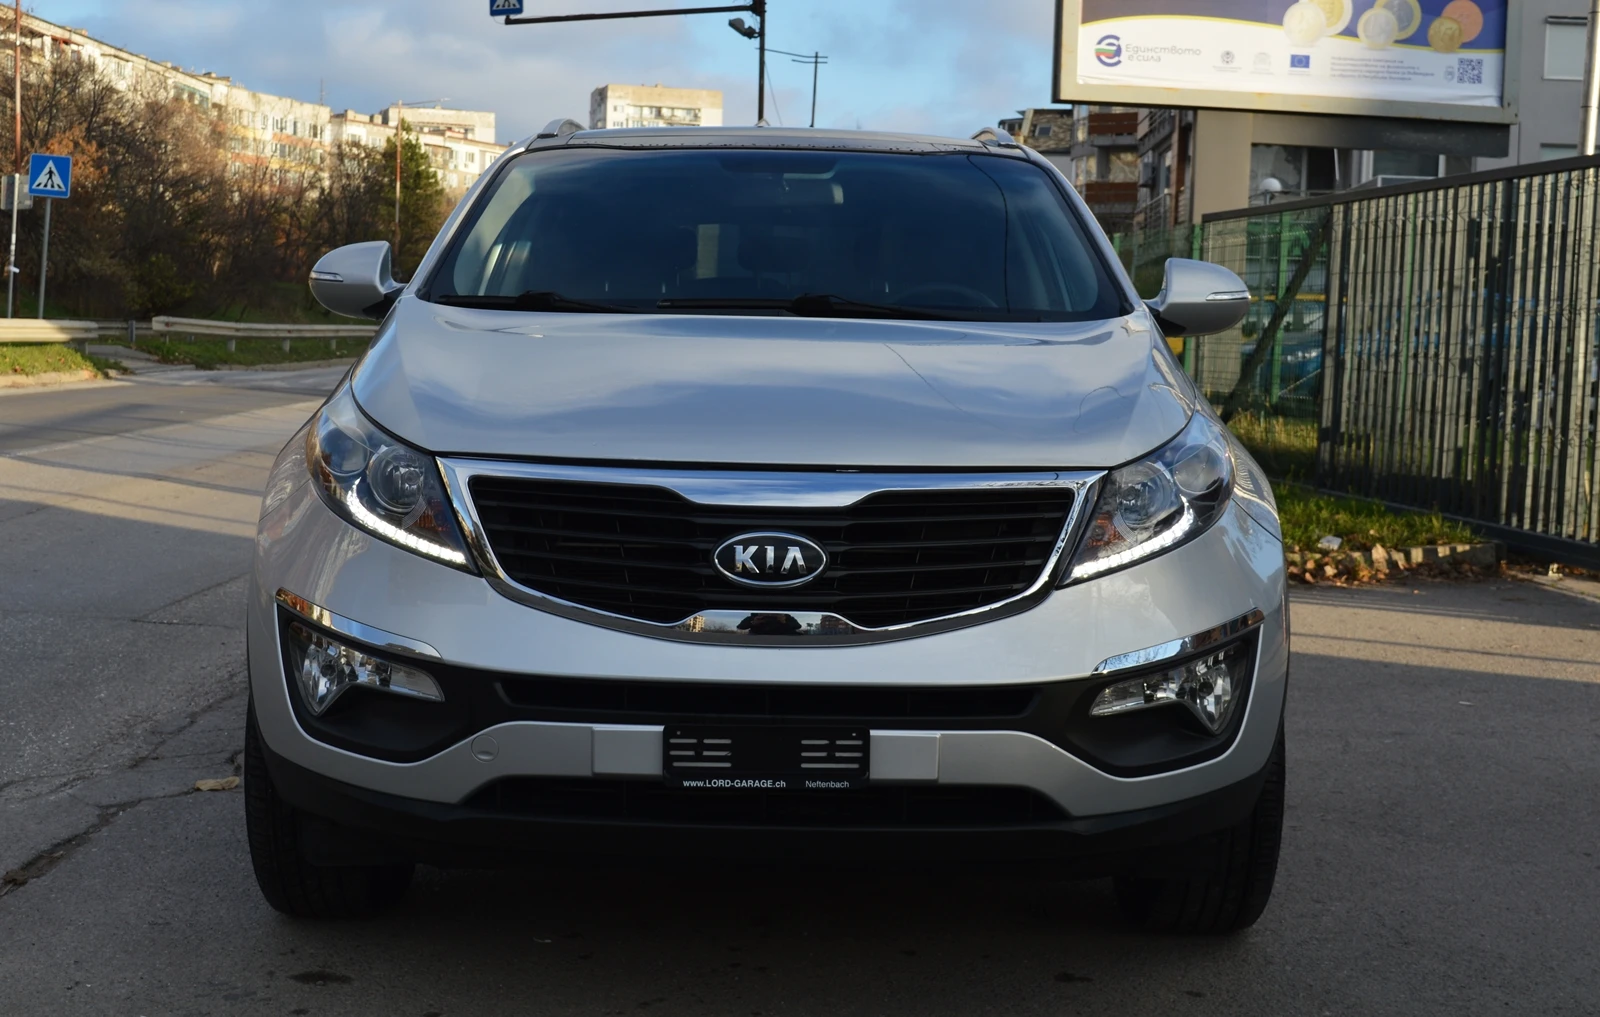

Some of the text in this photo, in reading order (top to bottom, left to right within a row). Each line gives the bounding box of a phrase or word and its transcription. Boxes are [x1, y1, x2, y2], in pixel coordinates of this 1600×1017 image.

[1125, 43, 1202, 56] Единството
[1136, 54, 1161, 63] сила
[733, 545, 807, 574] KIA
[682, 779, 850, 788] www.LORD-GARAGE.ch Neftenbach
